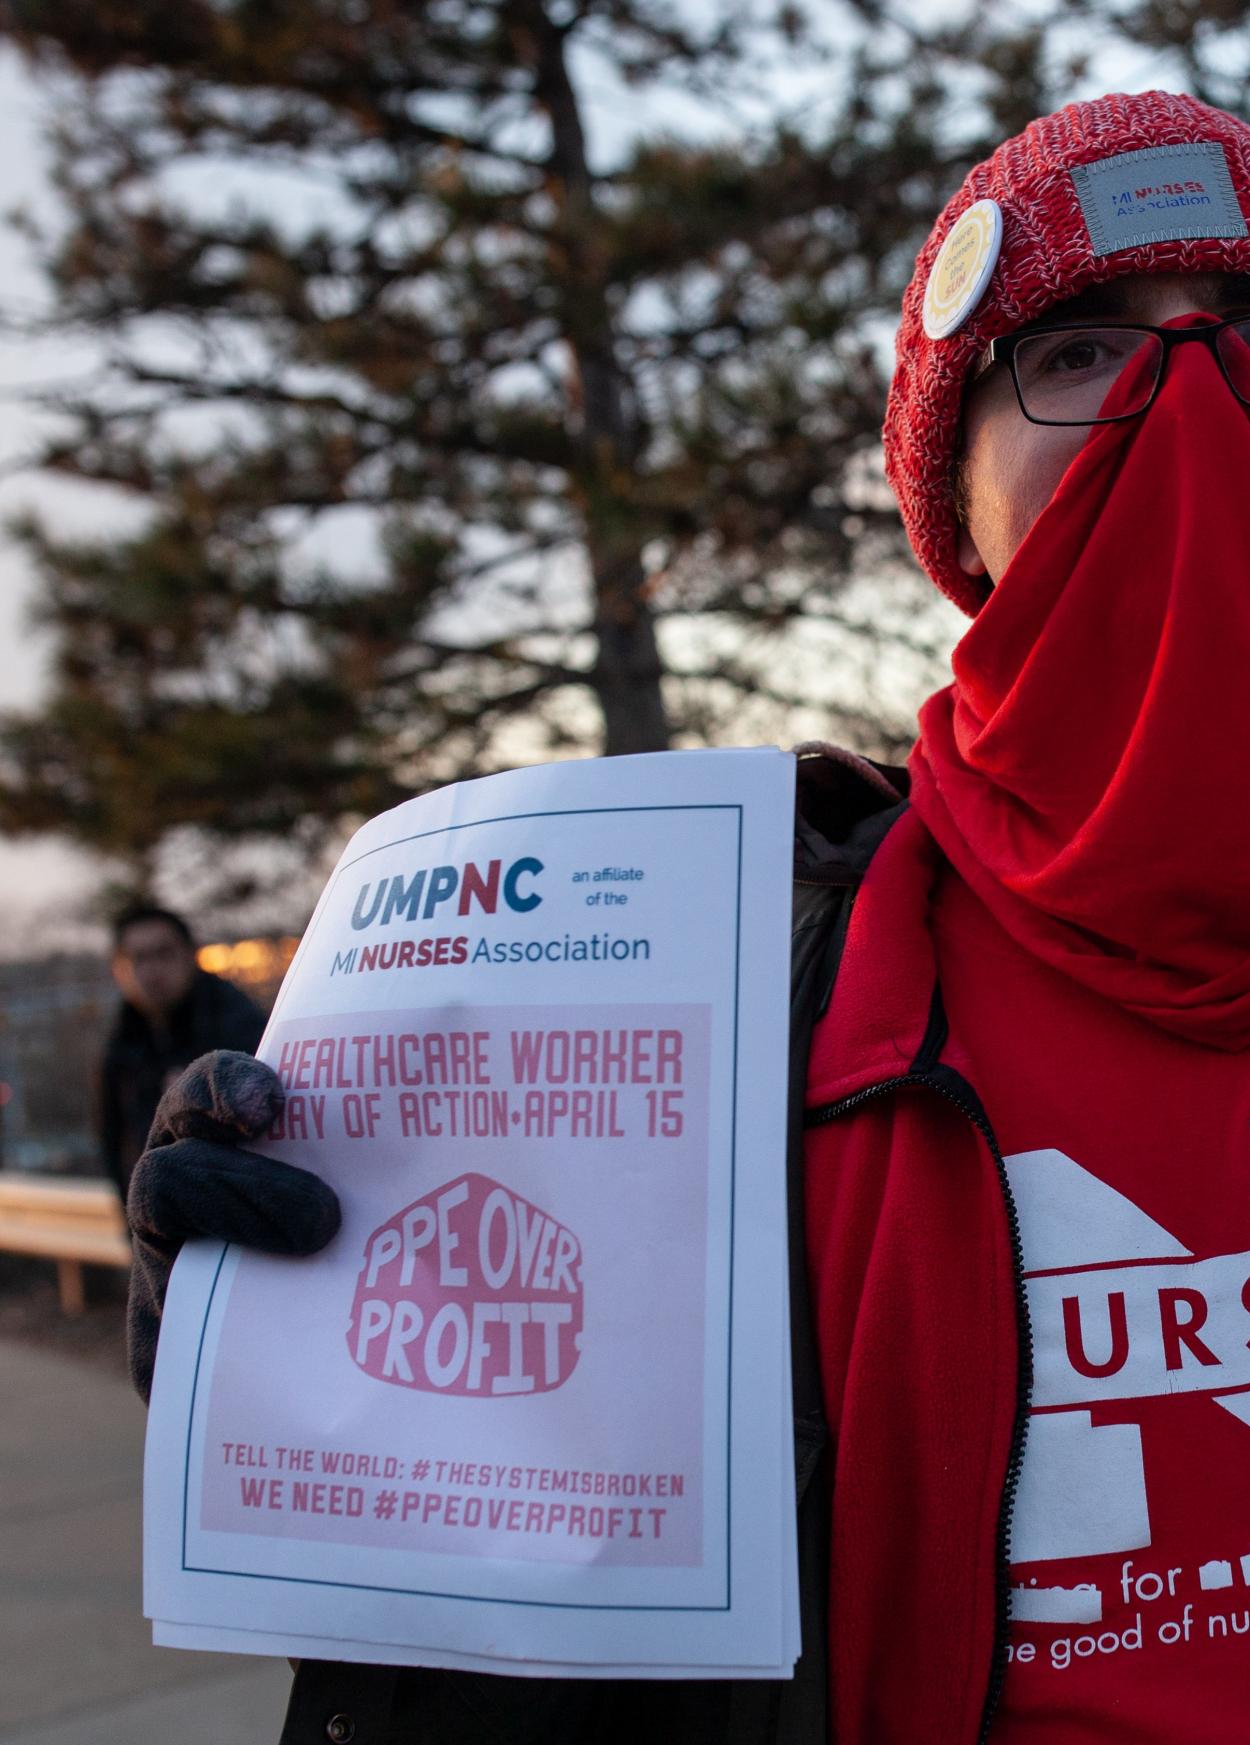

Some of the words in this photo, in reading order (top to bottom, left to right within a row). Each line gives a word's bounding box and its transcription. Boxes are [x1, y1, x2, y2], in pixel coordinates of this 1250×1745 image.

[351, 857, 545, 931] UMPNC
[572, 873, 589, 883] an
[592, 867, 644, 882] affiliate
[586, 892, 602, 906] of
[604, 892, 628, 905] the
[330, 951, 357, 977] MI
[358, 936, 469, 973] NURSES
[472, 934, 650, 963] Association
[277, 1031, 490, 1090] HEALTHCARE
[511, 1030, 683, 1084] WORKER
[342, 1093, 381, 1138] OF
[645, 1090, 683, 1137] 15
[365, 1181, 468, 1288] PPE
[478, 1188, 578, 1293] OVER
[356, 1300, 572, 1394] PROFIT
[222, 1443, 268, 1467] TELL
[275, 1447, 314, 1471] THE
[321, 1451, 405, 1480] WORLD:
[411, 1459, 684, 1497] #THESYSTEMISBROKEN
[241, 1477, 282, 1511] WE
[292, 1482, 364, 1517] NEED
[373, 1491, 667, 1539] #PPEOVERPROFIT
[1121, 1561, 1182, 1604] for
[1050, 1613, 1143, 1670] good
[1158, 1604, 1193, 1635] of
